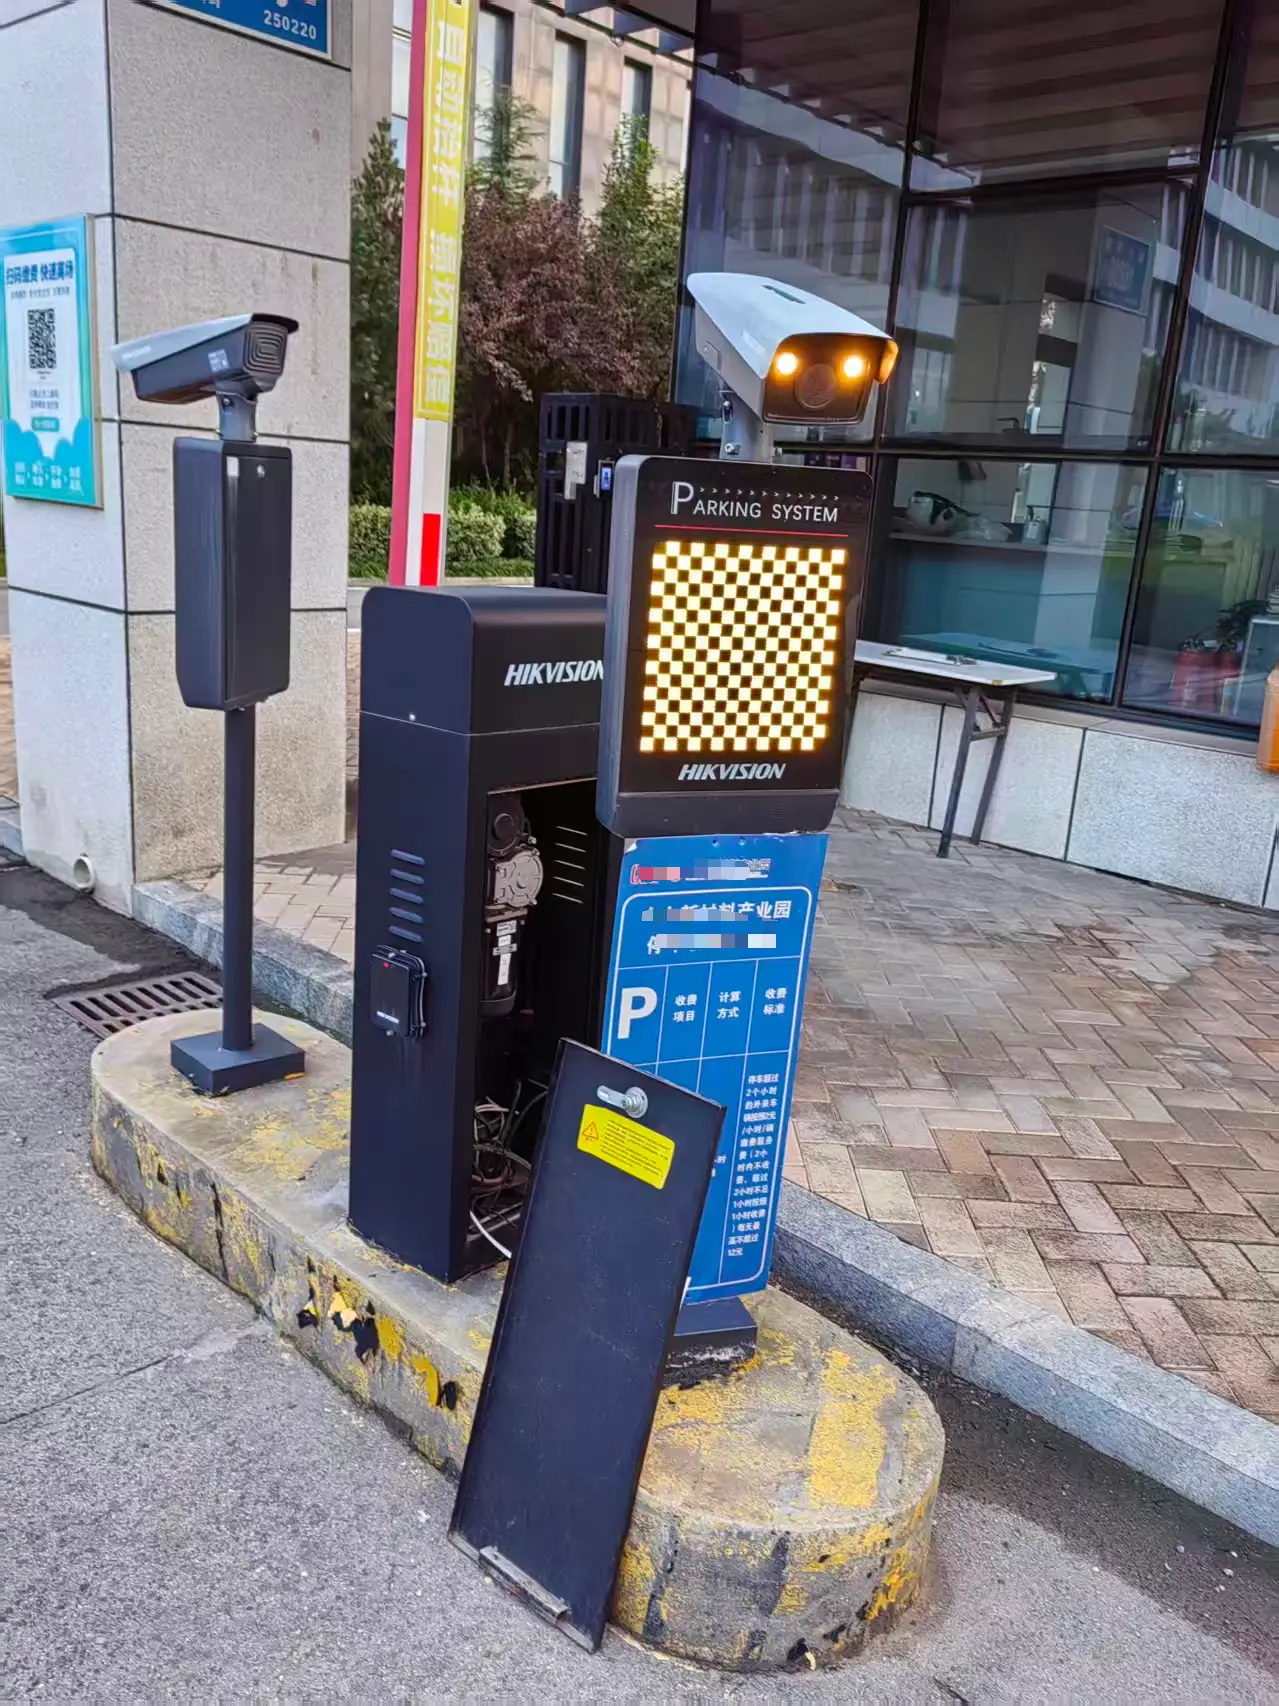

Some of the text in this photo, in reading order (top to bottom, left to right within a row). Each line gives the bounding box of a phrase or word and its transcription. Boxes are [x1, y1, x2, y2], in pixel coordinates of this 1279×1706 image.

[263, 10, 316, 40] 250220
[772, 503, 839, 522] SYSTEM
[503, 659, 604, 687] HIKVISION
[678, 763, 787, 781] HIKVISION
[675, 994, 697, 1007] 收费
[719, 991, 741, 1004] 计算
[765, 988, 788, 1000] 收费
[617, 986, 658, 1040] P
[672, 1010, 695, 1023] 项目
[717, 1007, 740, 1020] 方式
[763, 1004, 785, 1016] 标准
[745, 1086, 777, 1097] 2个小时
